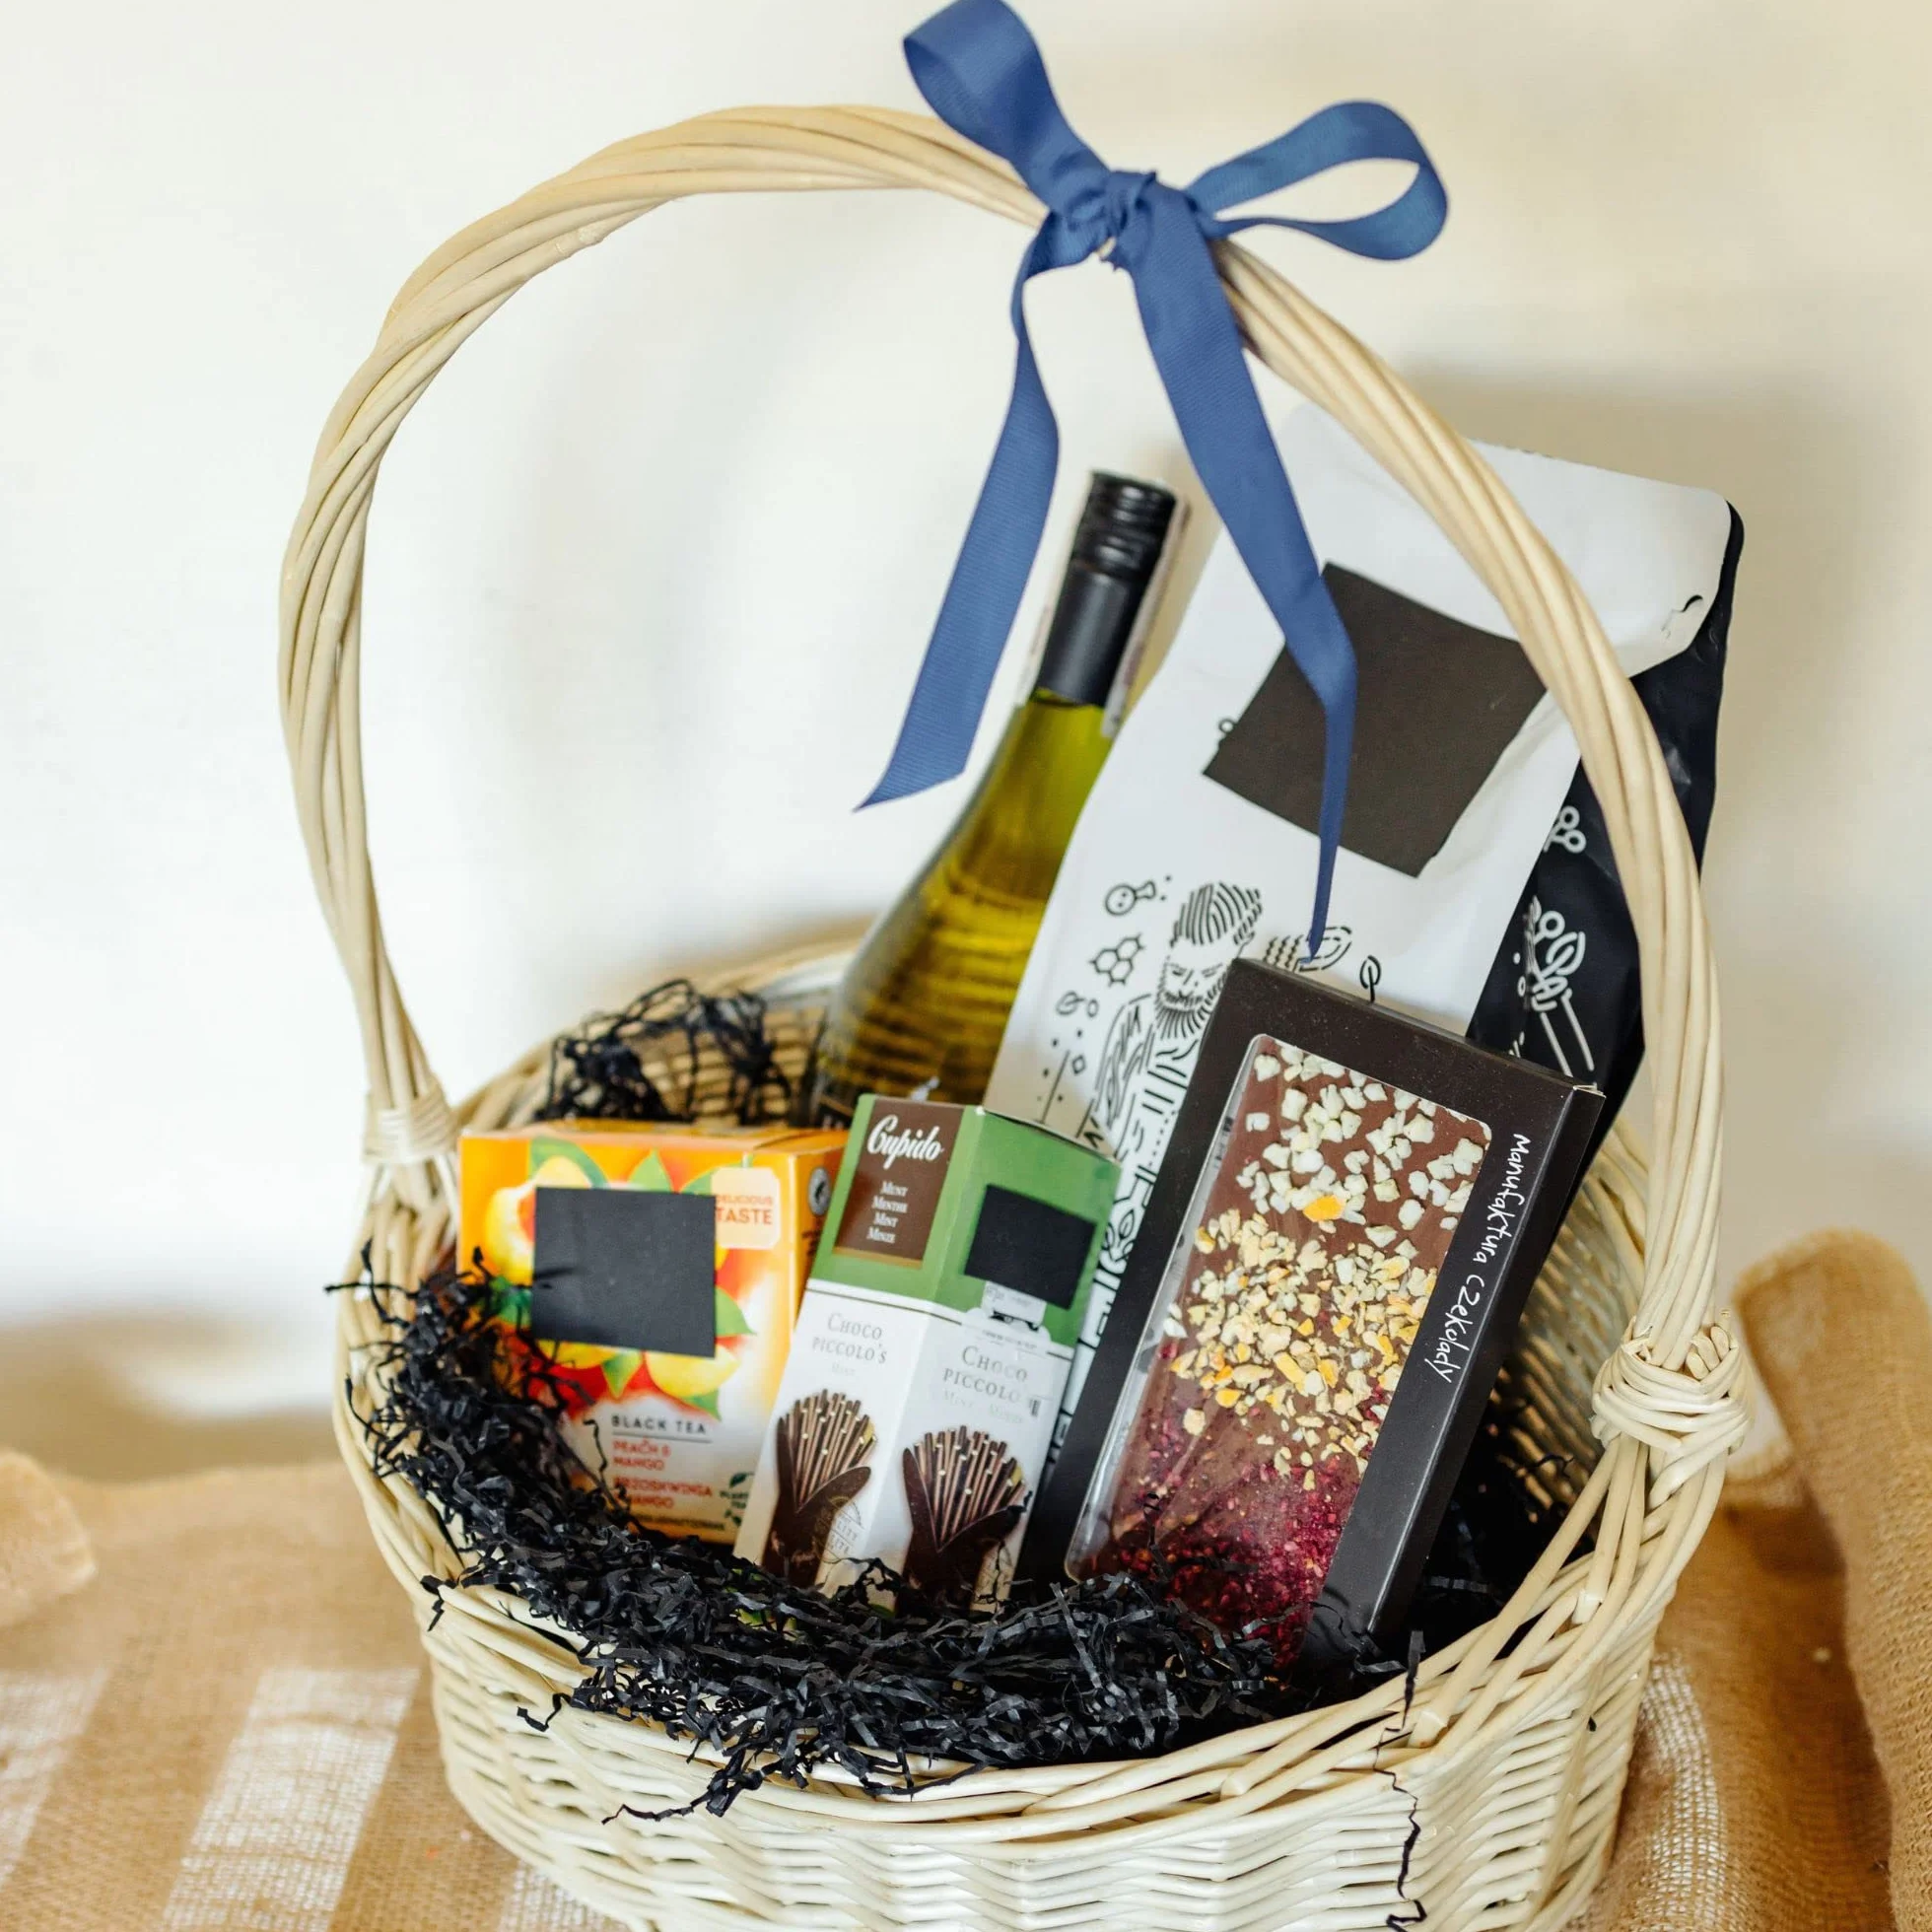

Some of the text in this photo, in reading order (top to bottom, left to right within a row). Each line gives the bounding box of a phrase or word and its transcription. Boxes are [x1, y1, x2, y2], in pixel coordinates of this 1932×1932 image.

[867, 1114, 944, 1170] Cupido
[716, 1207, 773, 1225] TASTE
[1423, 1134, 1532, 1384] Manufaktura czekolady
[611, 1414, 708, 1434] BLACK TEA
